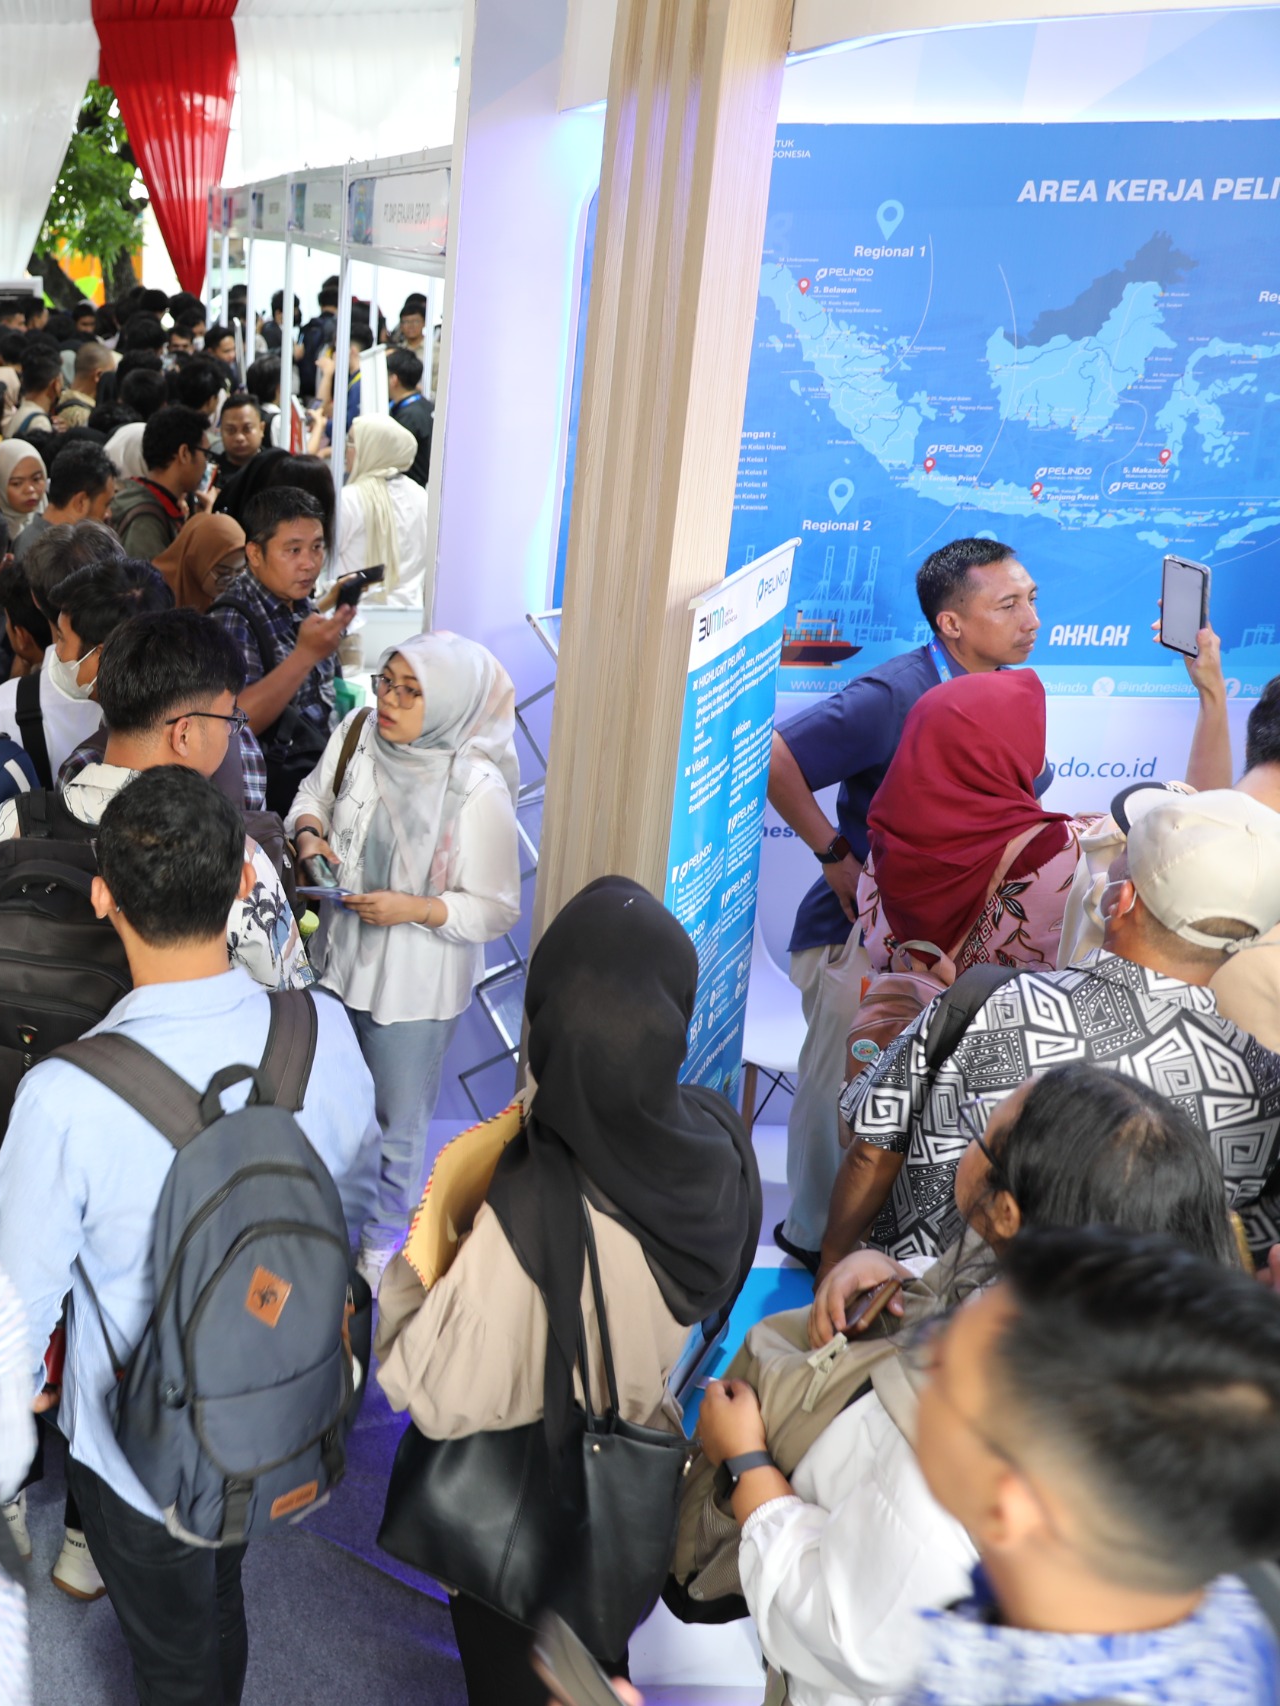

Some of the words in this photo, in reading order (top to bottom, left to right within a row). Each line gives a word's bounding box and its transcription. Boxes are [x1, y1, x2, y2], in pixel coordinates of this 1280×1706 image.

[773, 139, 795, 148] TUK
[1017, 179, 1098, 203] AREA
[1105, 178, 1205, 202] KERJA
[853, 245, 914, 260] Regional
[919, 245, 926, 257] 1
[829, 267, 874, 276] PELINDO
[814, 286, 822, 294] 3.
[823, 286, 857, 294] Belawan
[748, 443, 765, 451] Kelas
[766, 443, 787, 451] Utama
[939, 444, 983, 453] PELINDO
[1047, 467, 1093, 475] PELINDO
[1132, 466, 1170, 474] Makassar
[929, 474, 957, 483] Tanjung
[1121, 481, 1167, 490] PELINDO
[1046, 493, 1076, 502] Tanjung
[1077, 493, 1100, 501] Perak
[802, 520, 859, 533] Regional
[863, 520, 872, 531] 2
[764, 567, 789, 598] PELINDO
[1048, 624, 1131, 647] AKHLAK
[699, 659, 728, 689] HIGHLIGHT
[728, 646, 746, 669] PELINDO
[691, 755, 710, 775] Vision
[736, 797, 758, 822] PELINDO
[688, 842, 712, 870] PELINDO
[730, 870, 752, 897] PELINDO
